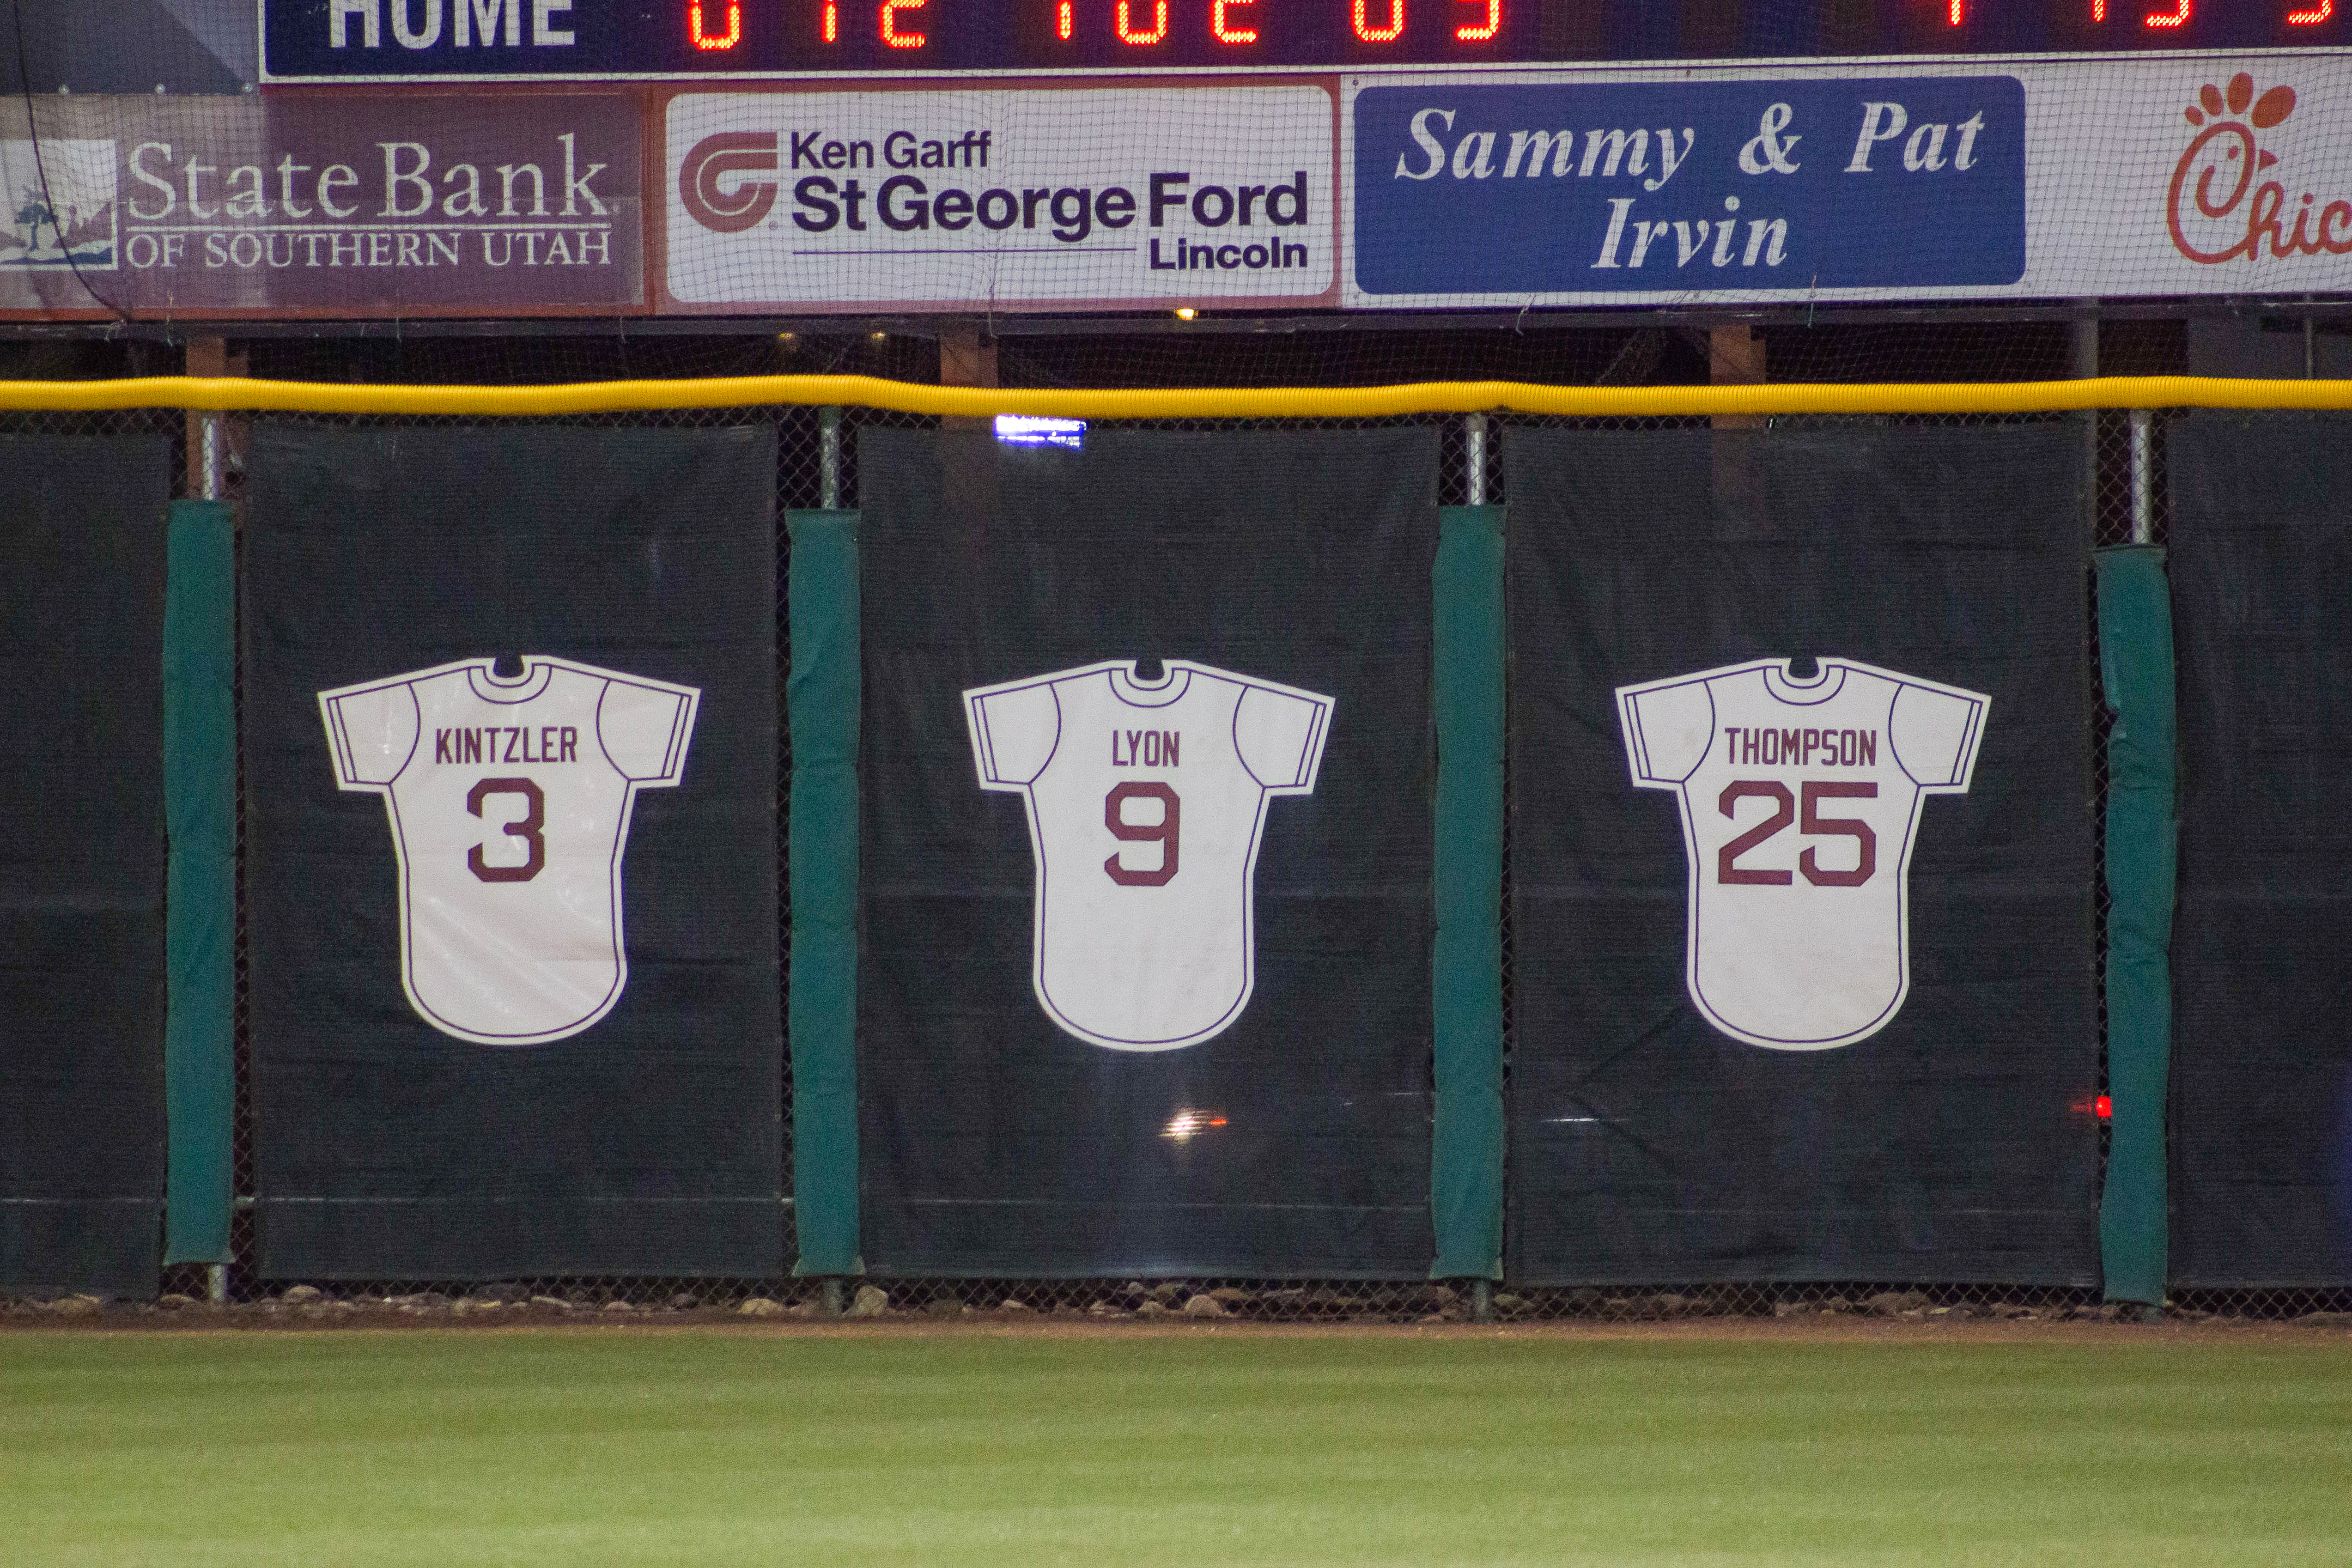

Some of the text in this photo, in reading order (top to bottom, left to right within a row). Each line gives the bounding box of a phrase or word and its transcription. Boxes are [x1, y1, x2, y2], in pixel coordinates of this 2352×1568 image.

[330, 0, 575, 49] HOME
[125, 133, 609, 220] State Bank
[791, 130, 991, 169] Ken Garff
[1395, 103, 1984, 191] Sammy & Pat
[792, 171, 1307, 243] St George Ford
[1592, 196, 1787, 268] Irvin
[125, 231, 611, 269] OF SOUTHERN UTAH
[1150, 237, 1307, 270] Lincoln
[436, 727, 577, 764] KINTZLER
[1112, 730, 1179, 767] LYON
[1725, 728, 1876, 766] THOMPSON
[467, 778, 545, 882] 3
[1104, 782, 1180, 887] 9
[1718, 780, 1878, 887] 25
